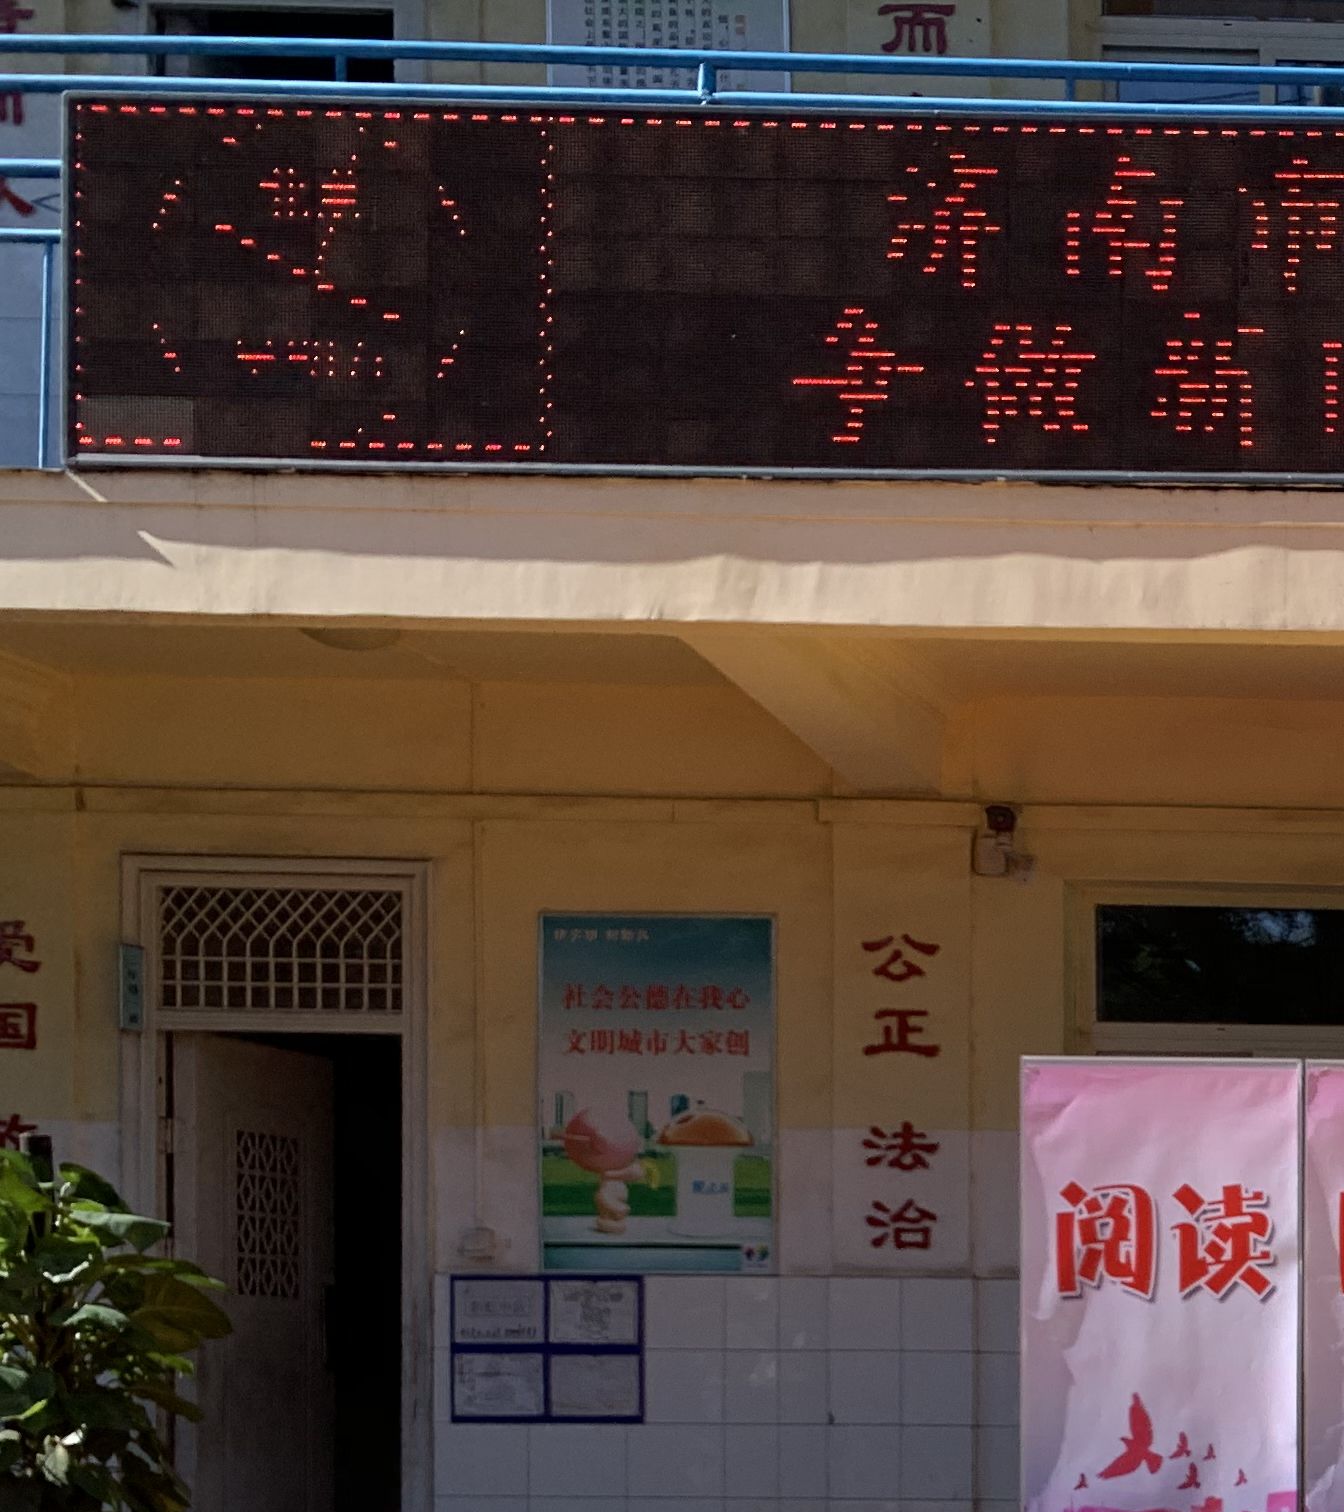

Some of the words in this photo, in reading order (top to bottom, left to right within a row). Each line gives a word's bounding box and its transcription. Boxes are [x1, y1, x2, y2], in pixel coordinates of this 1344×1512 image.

[878, 3, 956, 55] 而
[562, 983, 751, 1011] 社会公德在我心
[861, 932, 941, 1058] 公正
[562, 1027, 751, 1058] 文明城市大家创
[862, 1121, 940, 1250] 法治
[1054, 1181, 1276, 1301] 阅读
